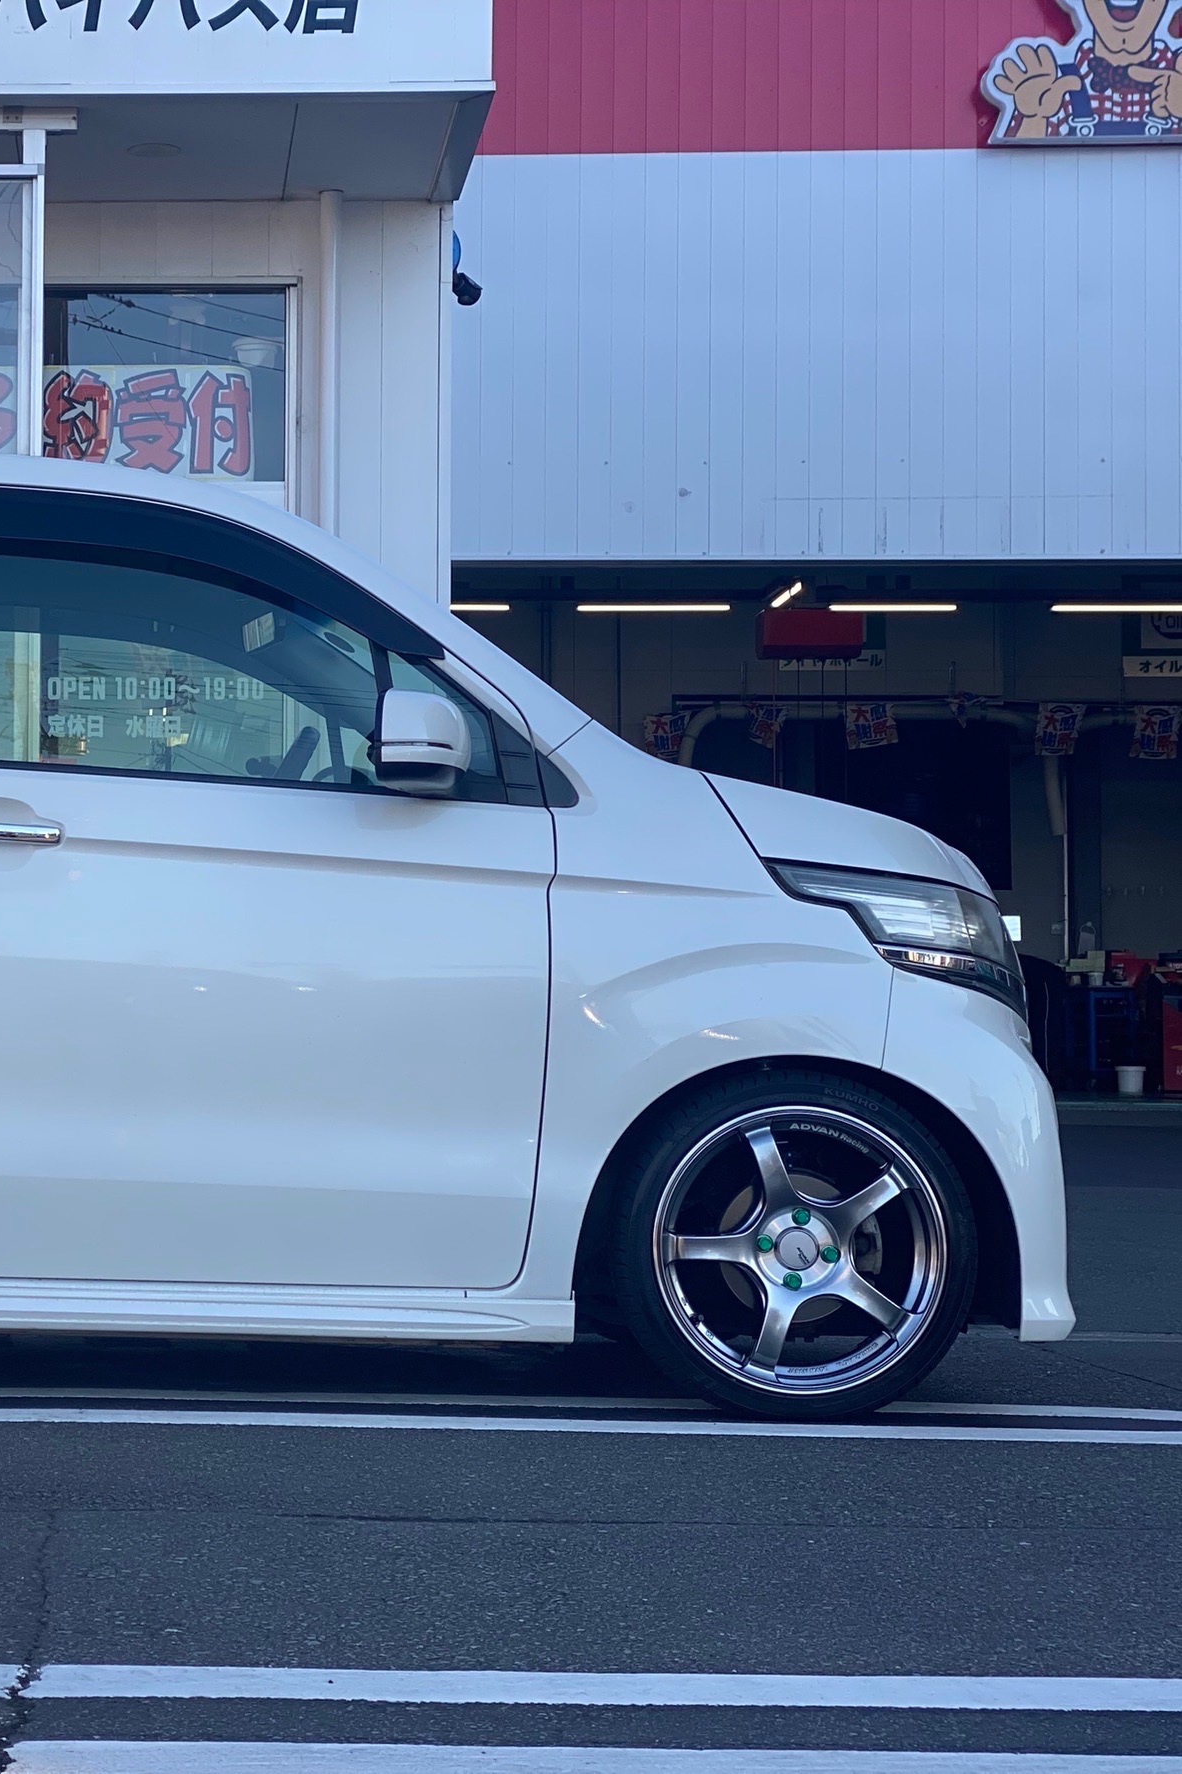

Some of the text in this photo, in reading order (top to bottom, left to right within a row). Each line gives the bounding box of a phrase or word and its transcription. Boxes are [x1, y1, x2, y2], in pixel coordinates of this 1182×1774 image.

[47, 677, 106, 700] OPEN
[47, 715, 104, 739] 定休日
[824, 1087, 880, 1112] KUMHO
[789, 1122, 870, 1154] ADVAN Racing
